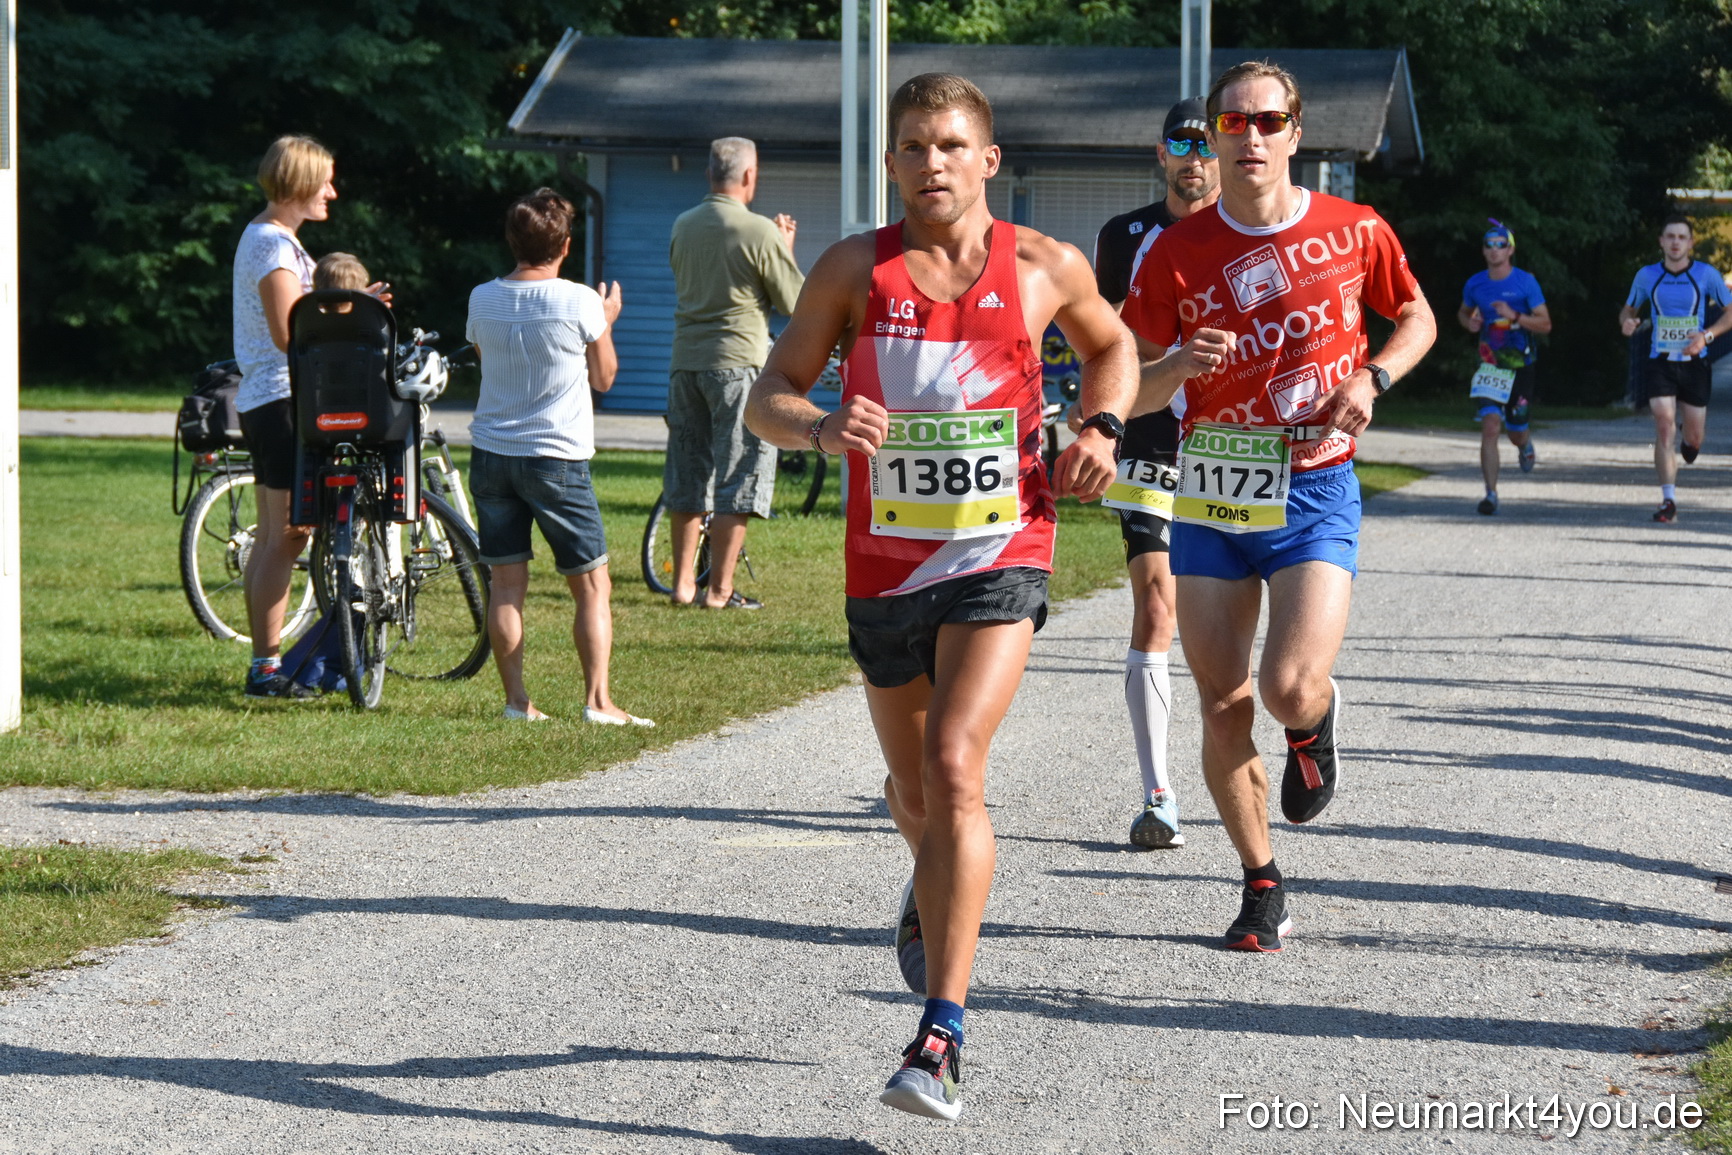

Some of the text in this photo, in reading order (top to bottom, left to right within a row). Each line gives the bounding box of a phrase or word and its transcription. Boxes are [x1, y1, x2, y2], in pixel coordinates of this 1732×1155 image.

[1228, 249, 1273, 278] raumbox
[1298, 261, 1355, 288] schenken
[888, 298, 915, 320] LG
[875, 321, 926, 337] Erlangen
[1237, 355, 1282, 380] wohnen
[1292, 331, 1336, 358] outdoor
[1270, 367, 1317, 392] raumbox
[1477, 374, 1508, 390] 2655
[887, 415, 1005, 446] BOCK
[1190, 429, 1279, 459] BOCK
[887, 455, 1001, 496] 1386
[1193, 462, 1274, 500] 1172
[1129, 487, 1166, 505] Peter
[1205, 503, 1250, 522] TOMS
